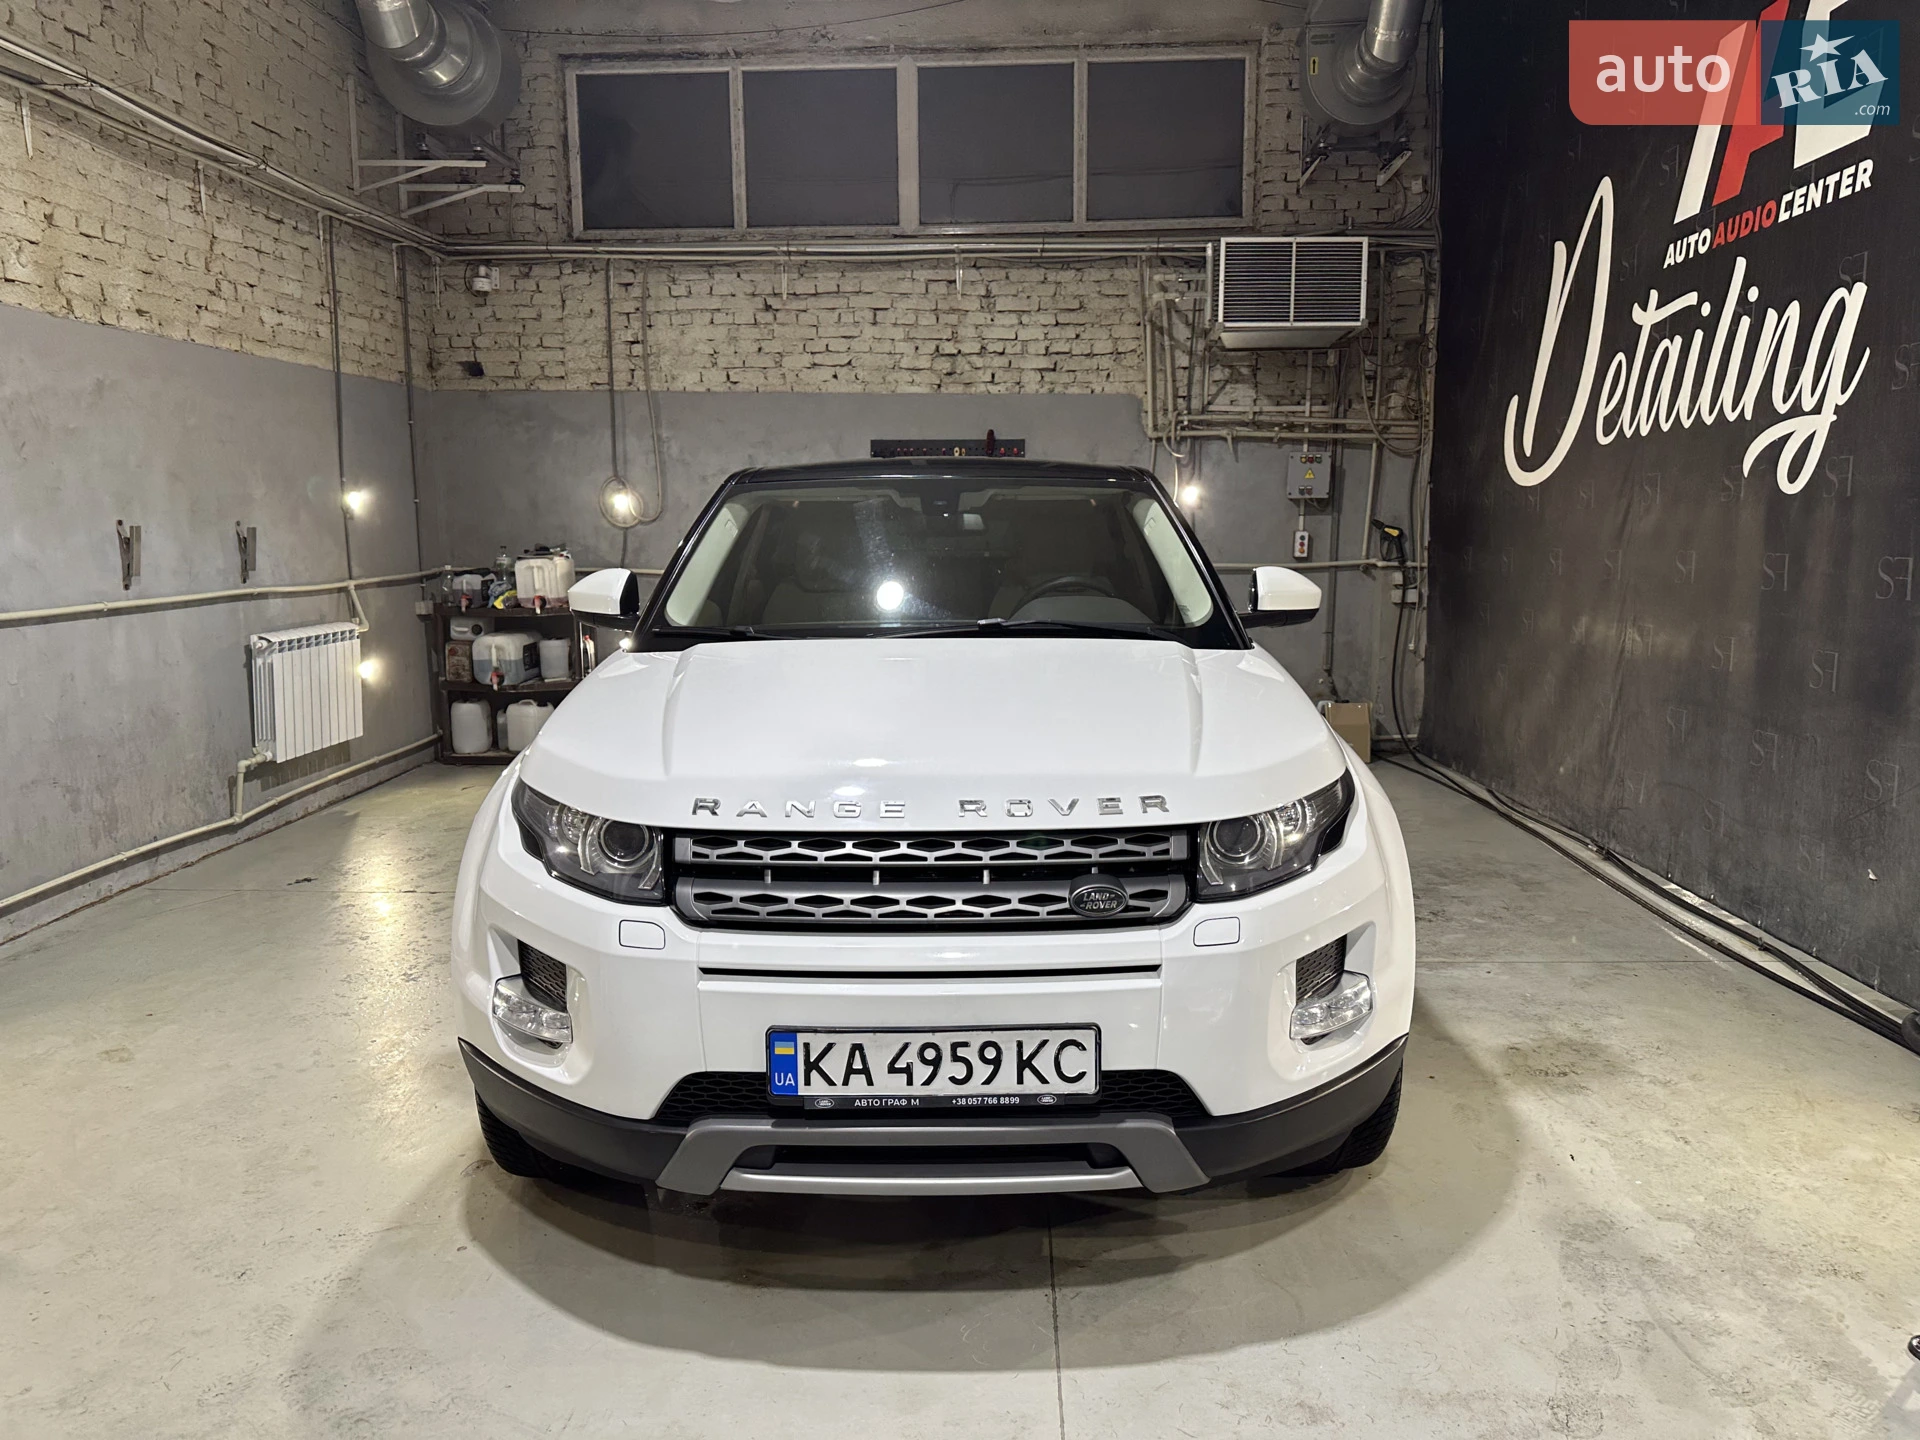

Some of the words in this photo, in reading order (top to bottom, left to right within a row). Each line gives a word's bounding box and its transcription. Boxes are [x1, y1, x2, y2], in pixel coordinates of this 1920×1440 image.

[1663, 228, 1712, 269] AUTO
[1711, 200, 1777, 249] AUDIO
[1777, 158, 1874, 223] CENTER
[1504, 176, 1871, 495] Detailing
[692, 797, 905, 819] RANGE
[958, 795, 1170, 818] ROVER
[803, 1042, 874, 1086] KA
[887, 1041, 1003, 1087] 4959
[1016, 1039, 1087, 1085] KC
[774, 1072, 795, 1086] UA
[854, 1098, 880, 1107] АВТО
[882, 1098, 907, 1107] ГРАФ
[999, 1096, 1020, 1105] 8899
